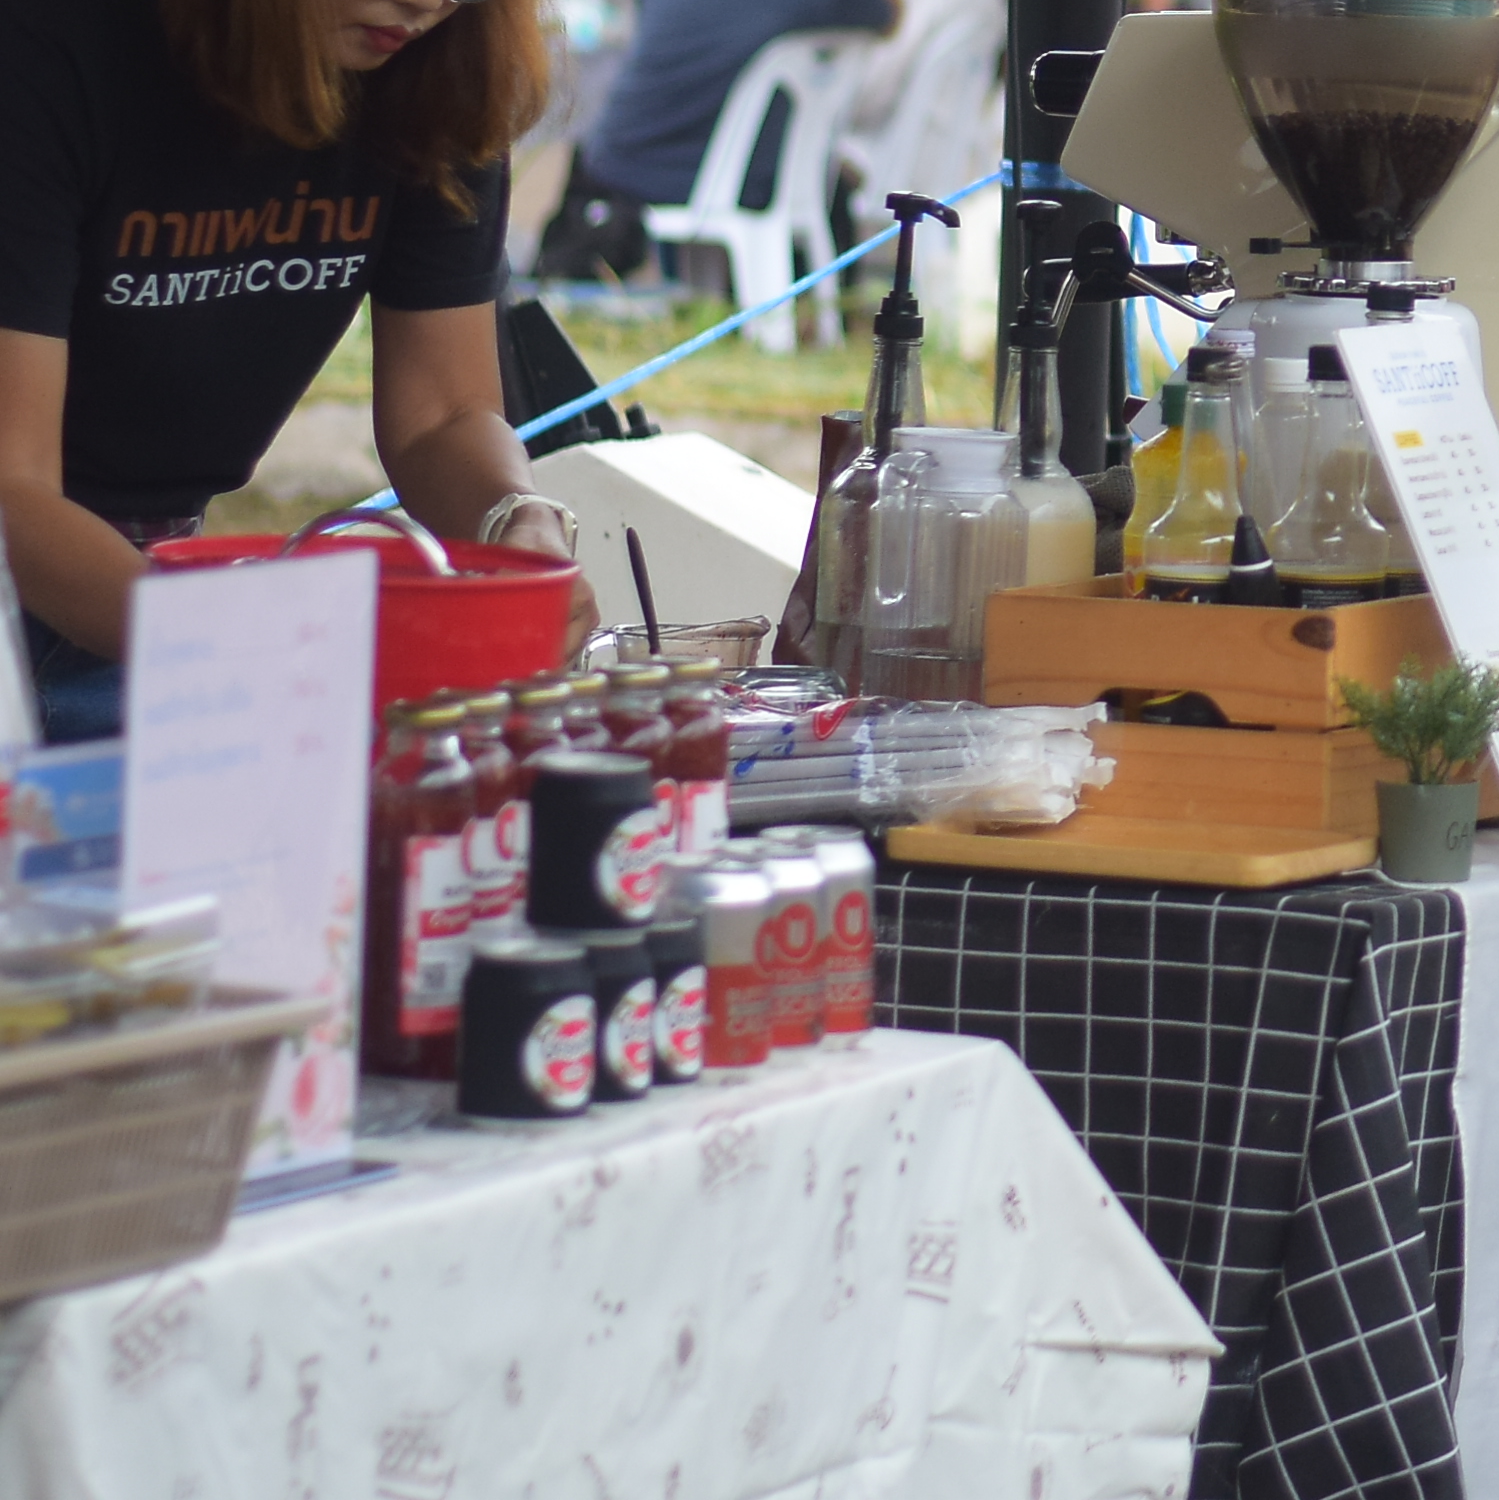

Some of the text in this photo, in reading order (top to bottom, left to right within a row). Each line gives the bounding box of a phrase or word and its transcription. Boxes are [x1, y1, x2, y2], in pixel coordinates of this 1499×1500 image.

[117, 181, 380, 258] กาแฟน่าน
[104, 254, 366, 307] SANTiiCOFF
